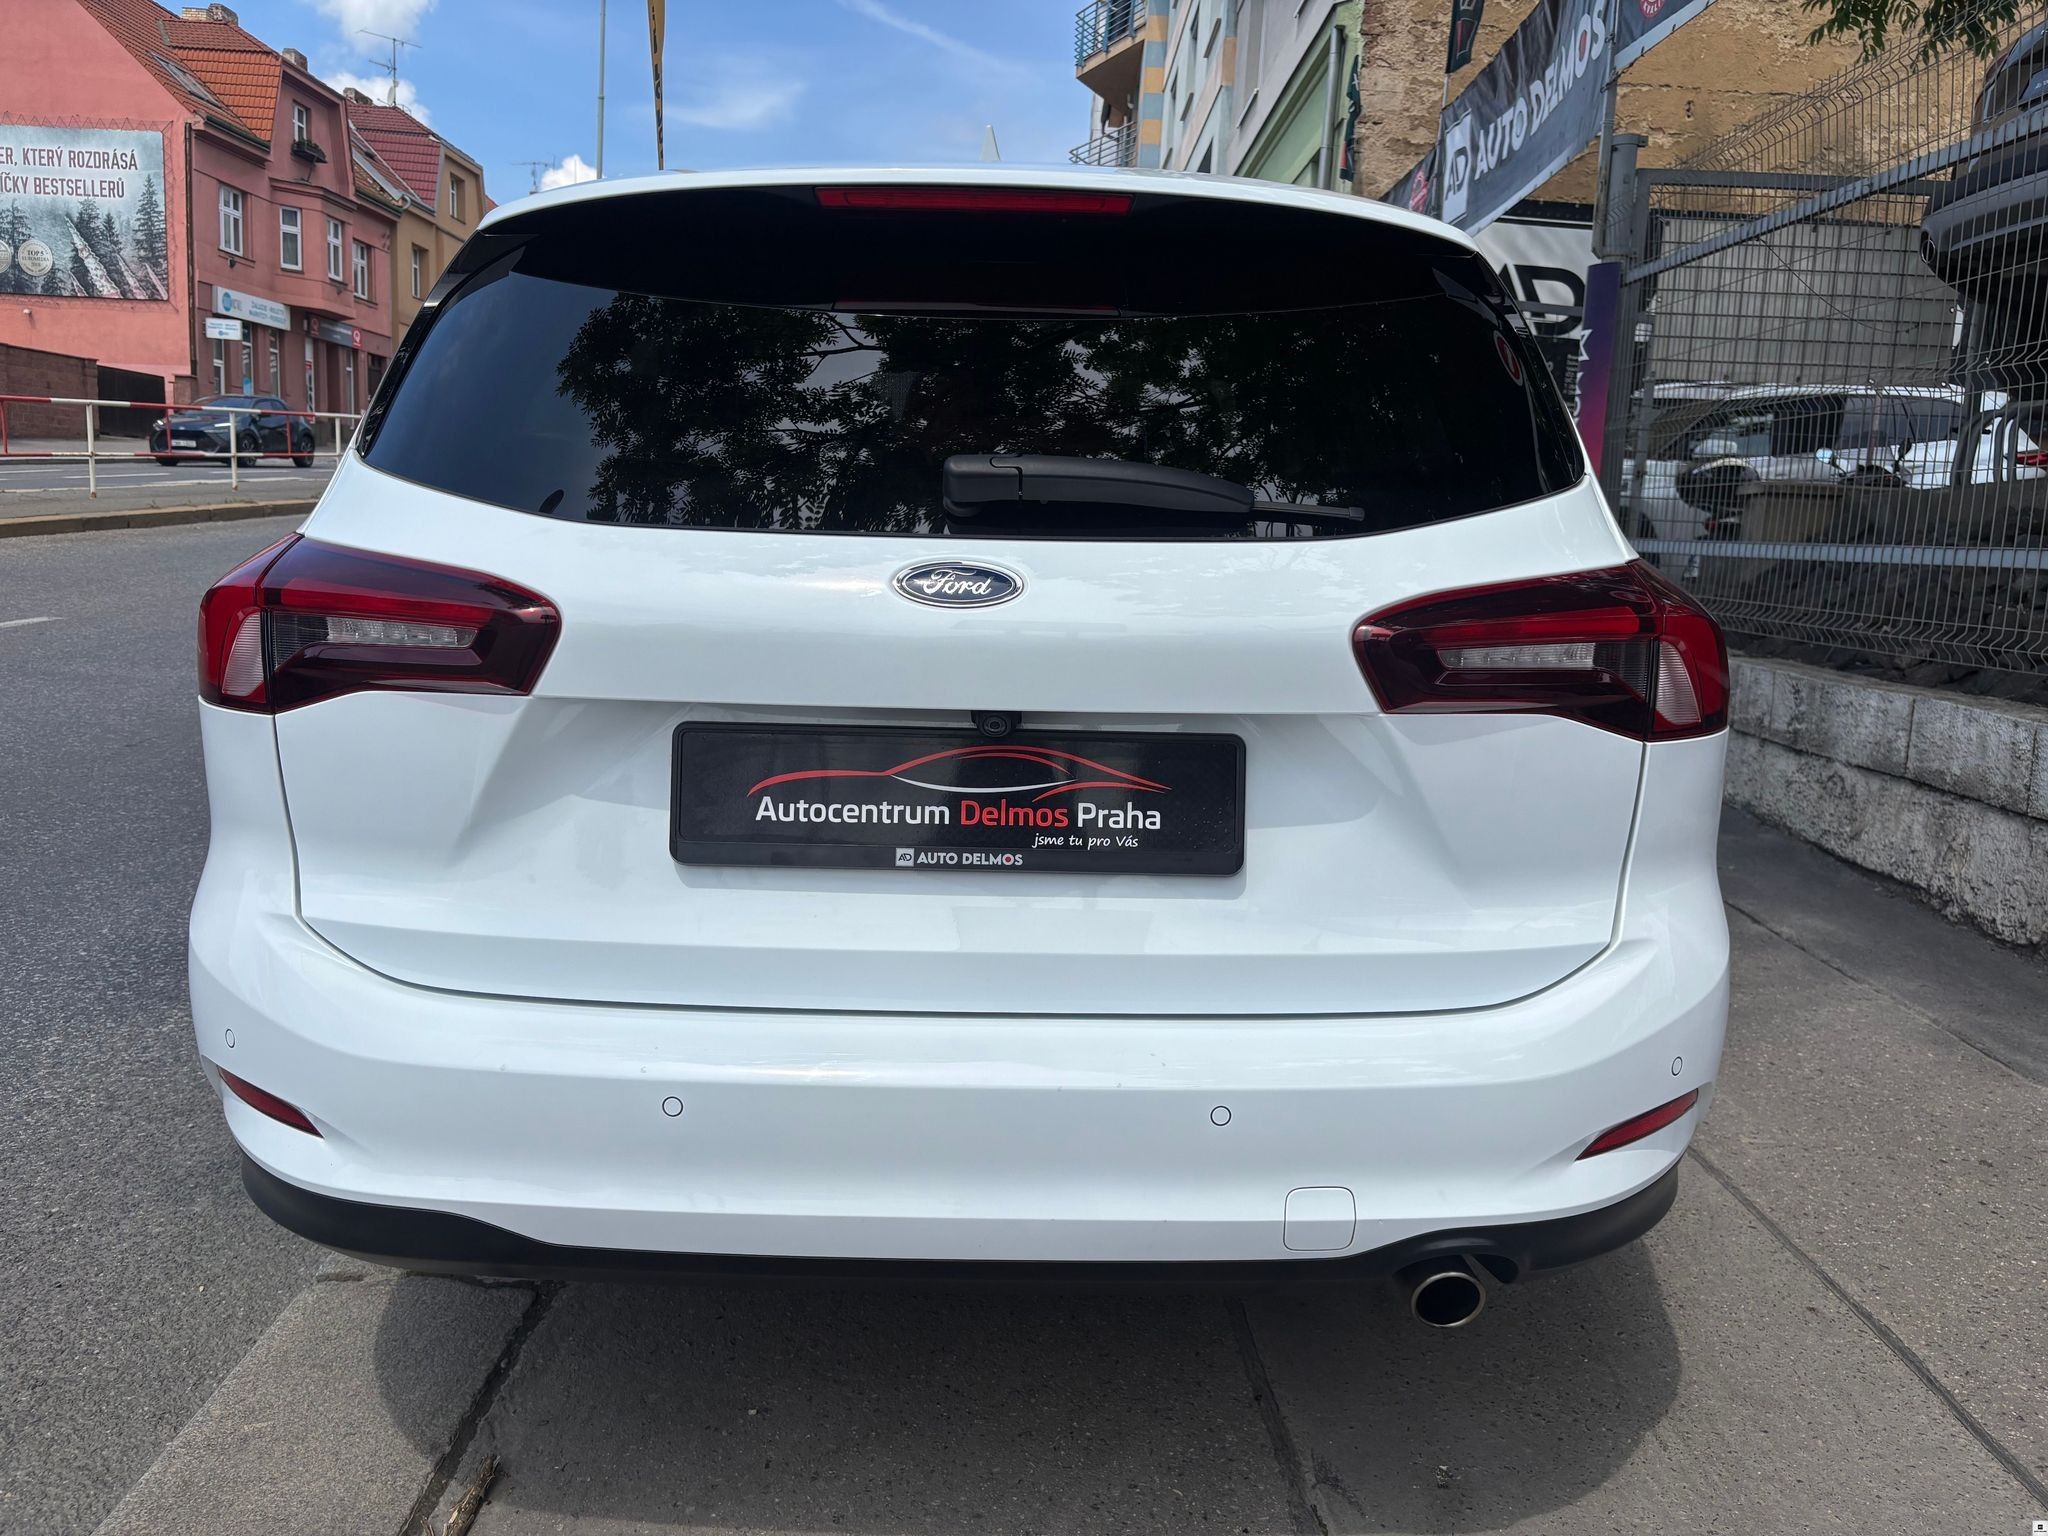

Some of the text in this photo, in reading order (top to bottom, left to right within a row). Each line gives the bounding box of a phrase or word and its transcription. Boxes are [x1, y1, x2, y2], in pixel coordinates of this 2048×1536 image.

[1474, 96, 1528, 181] AUTO
[22, 146, 64, 169] KTERÝ
[68, 148, 139, 171] ROZDRÁSÁ
[33, 177, 126, 199] BESTSELLERŮ
[920, 568, 992, 595] Ford
[755, 796, 1161, 830] Autocentrum Delmos Praha
[1031, 832, 1139, 851] jsme tu pro Vás
[916, 852, 958, 865] AUTO
[962, 853, 1024, 867] DELMOS
